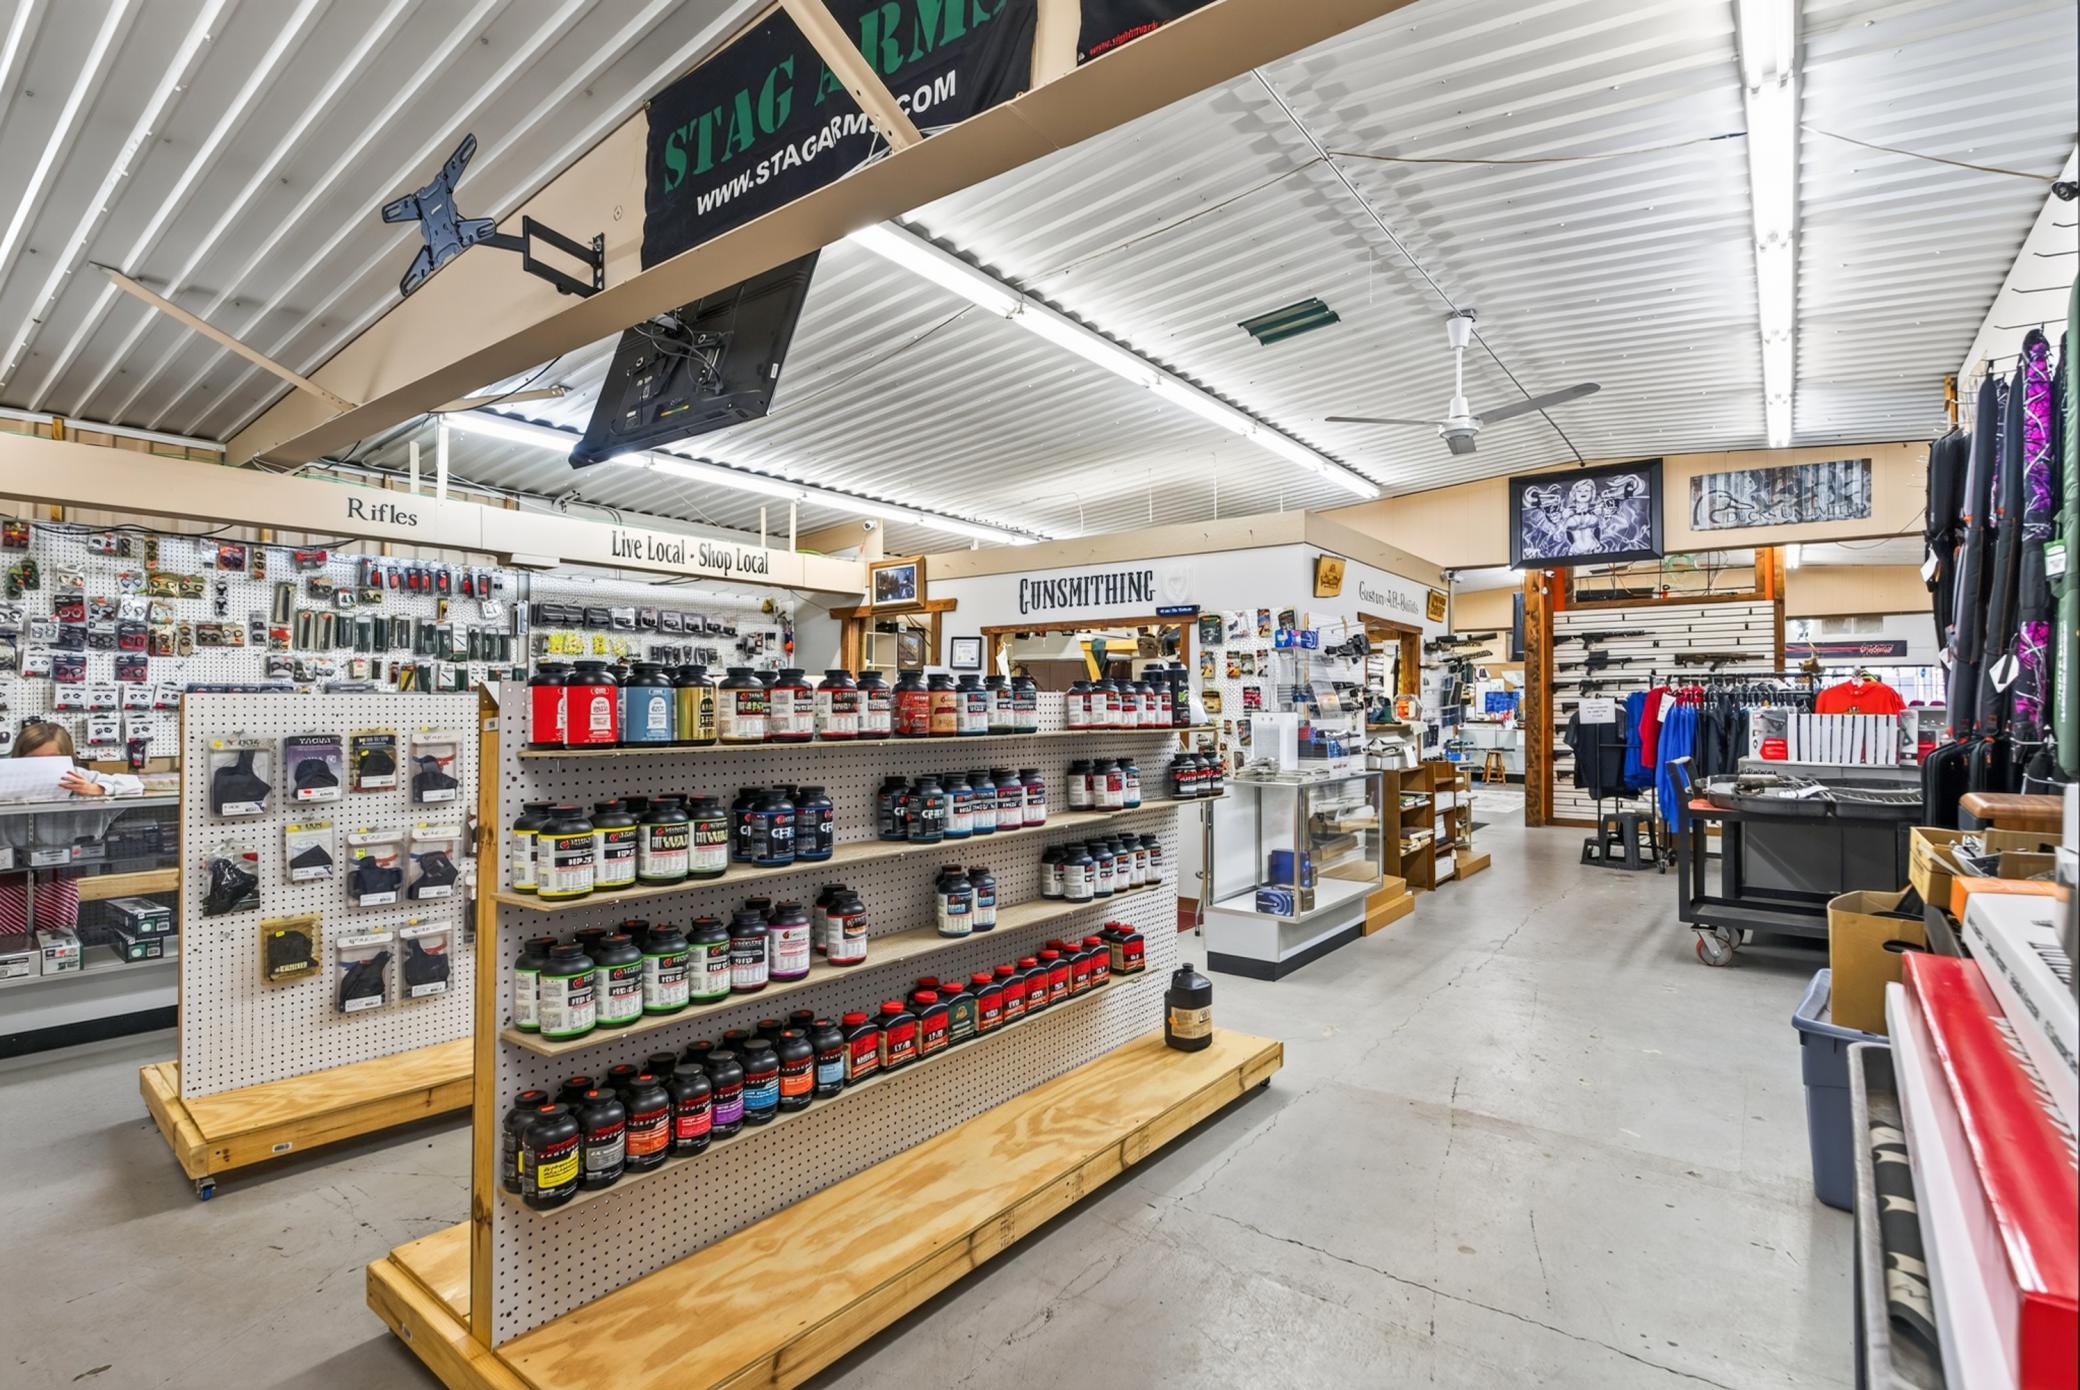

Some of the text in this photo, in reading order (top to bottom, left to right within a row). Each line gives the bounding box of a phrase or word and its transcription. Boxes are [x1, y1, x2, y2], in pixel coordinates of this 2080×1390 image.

[664, 54, 794, 193] STAG
[696, 69, 956, 216] WWW.STAGARMCOM
[347, 496, 418, 527] Rifles
[611, 530, 642, 559] Live
[647, 535, 685, 565] Local
[698, 542, 732, 576] Shop
[736, 547, 769, 575] Local
[1019, 570, 1156, 615] GUNSMITHING
